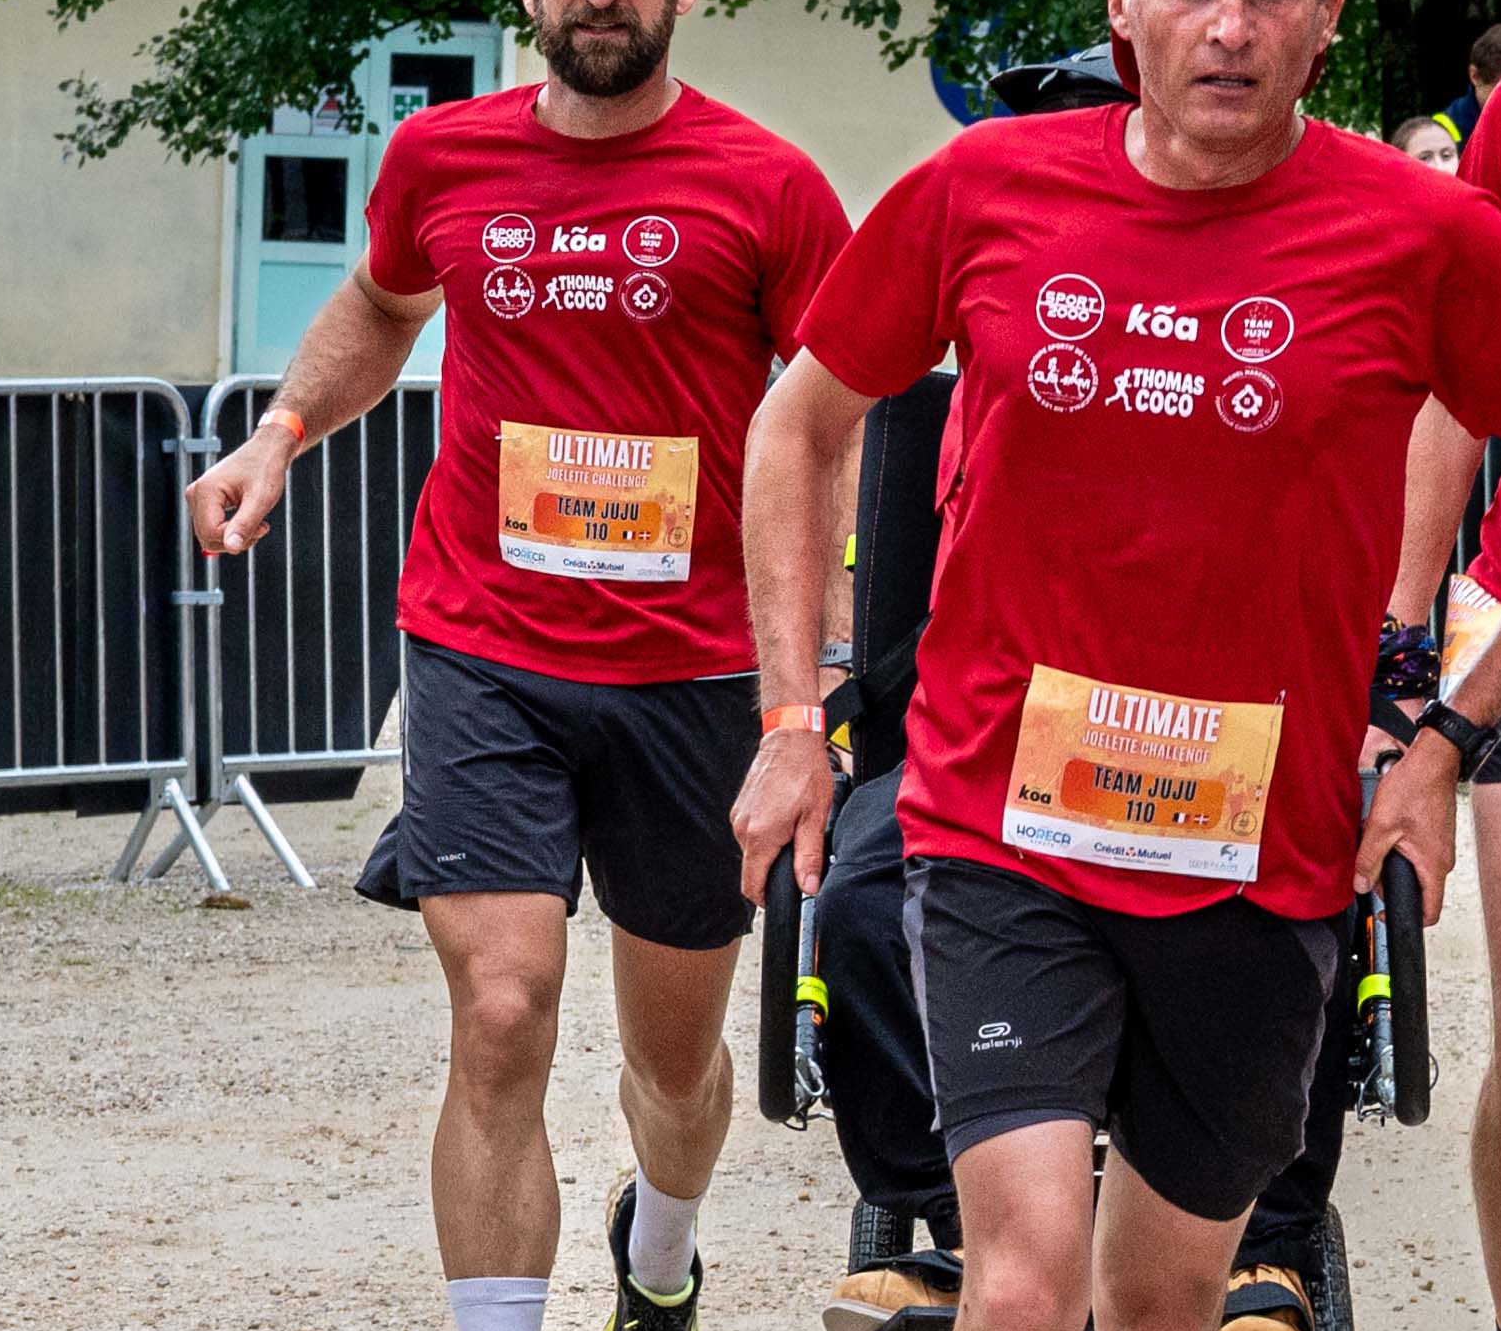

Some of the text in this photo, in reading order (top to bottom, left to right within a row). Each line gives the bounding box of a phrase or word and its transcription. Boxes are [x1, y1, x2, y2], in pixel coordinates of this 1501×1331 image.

[489, 227, 530, 238] SPORT
[491, 238, 525, 249] 2000
[558, 275, 614, 293] THOMAS
[563, 291, 607, 311] COCO
[1045, 291, 1099, 311] SPORT
[1047, 306, 1090, 323] 2000
[1243, 318, 1274, 329] TEAM
[1243, 329, 1270, 339] JUJU
[1132, 368, 1205, 396] THOMAS
[1135, 388, 1194, 418] COCO
[548, 433, 654, 470] ULTIMATE
[546, 467, 648, 489] JOELETTE CHALLENGE
[557, 497, 640, 522] TEAM JUJU
[585, 523, 609, 541] 110
[1087, 687, 1222, 743] ULTIMATE
[1082, 728, 1211, 765] JOELETTE CHALLENGE
[1093, 766, 1197, 802] TEAM JUJU
[1125, 799, 1155, 824] 110
[1016, 823, 1072, 845] HORECA
[1093, 841, 1125, 857] Crédit
[1137, 848, 1172, 861] Mutuel
[971, 1036, 1023, 1053] Kalenji
